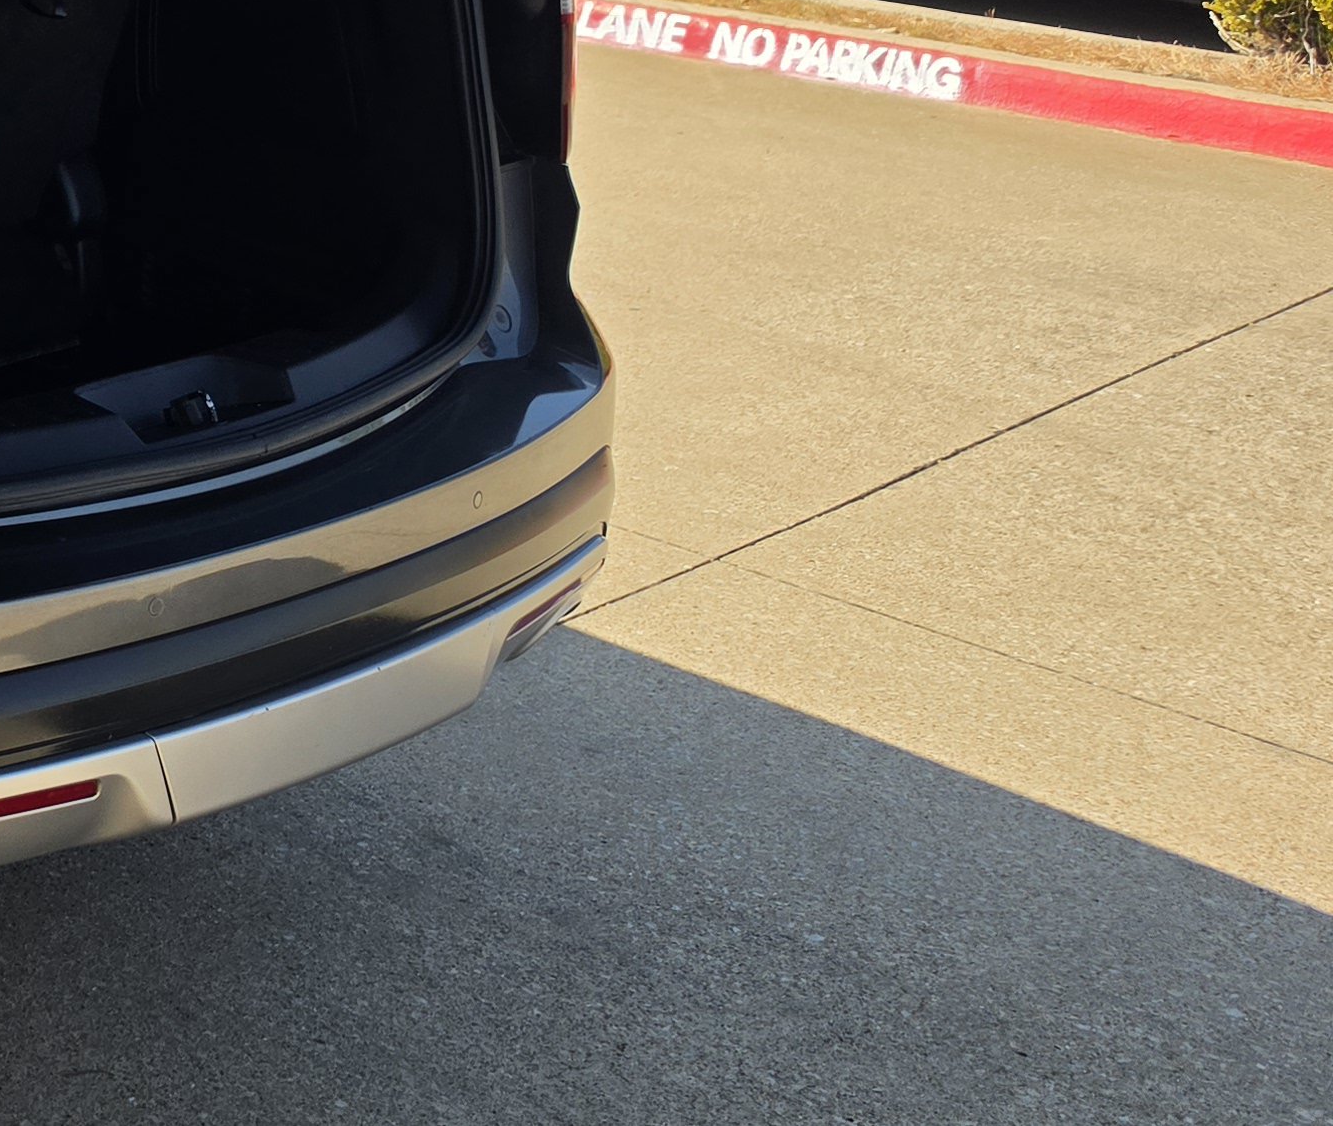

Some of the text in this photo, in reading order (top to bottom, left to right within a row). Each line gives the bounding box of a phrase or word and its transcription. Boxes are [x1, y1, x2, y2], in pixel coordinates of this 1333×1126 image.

[576, 0, 963, 101] LANE NO PARKING
